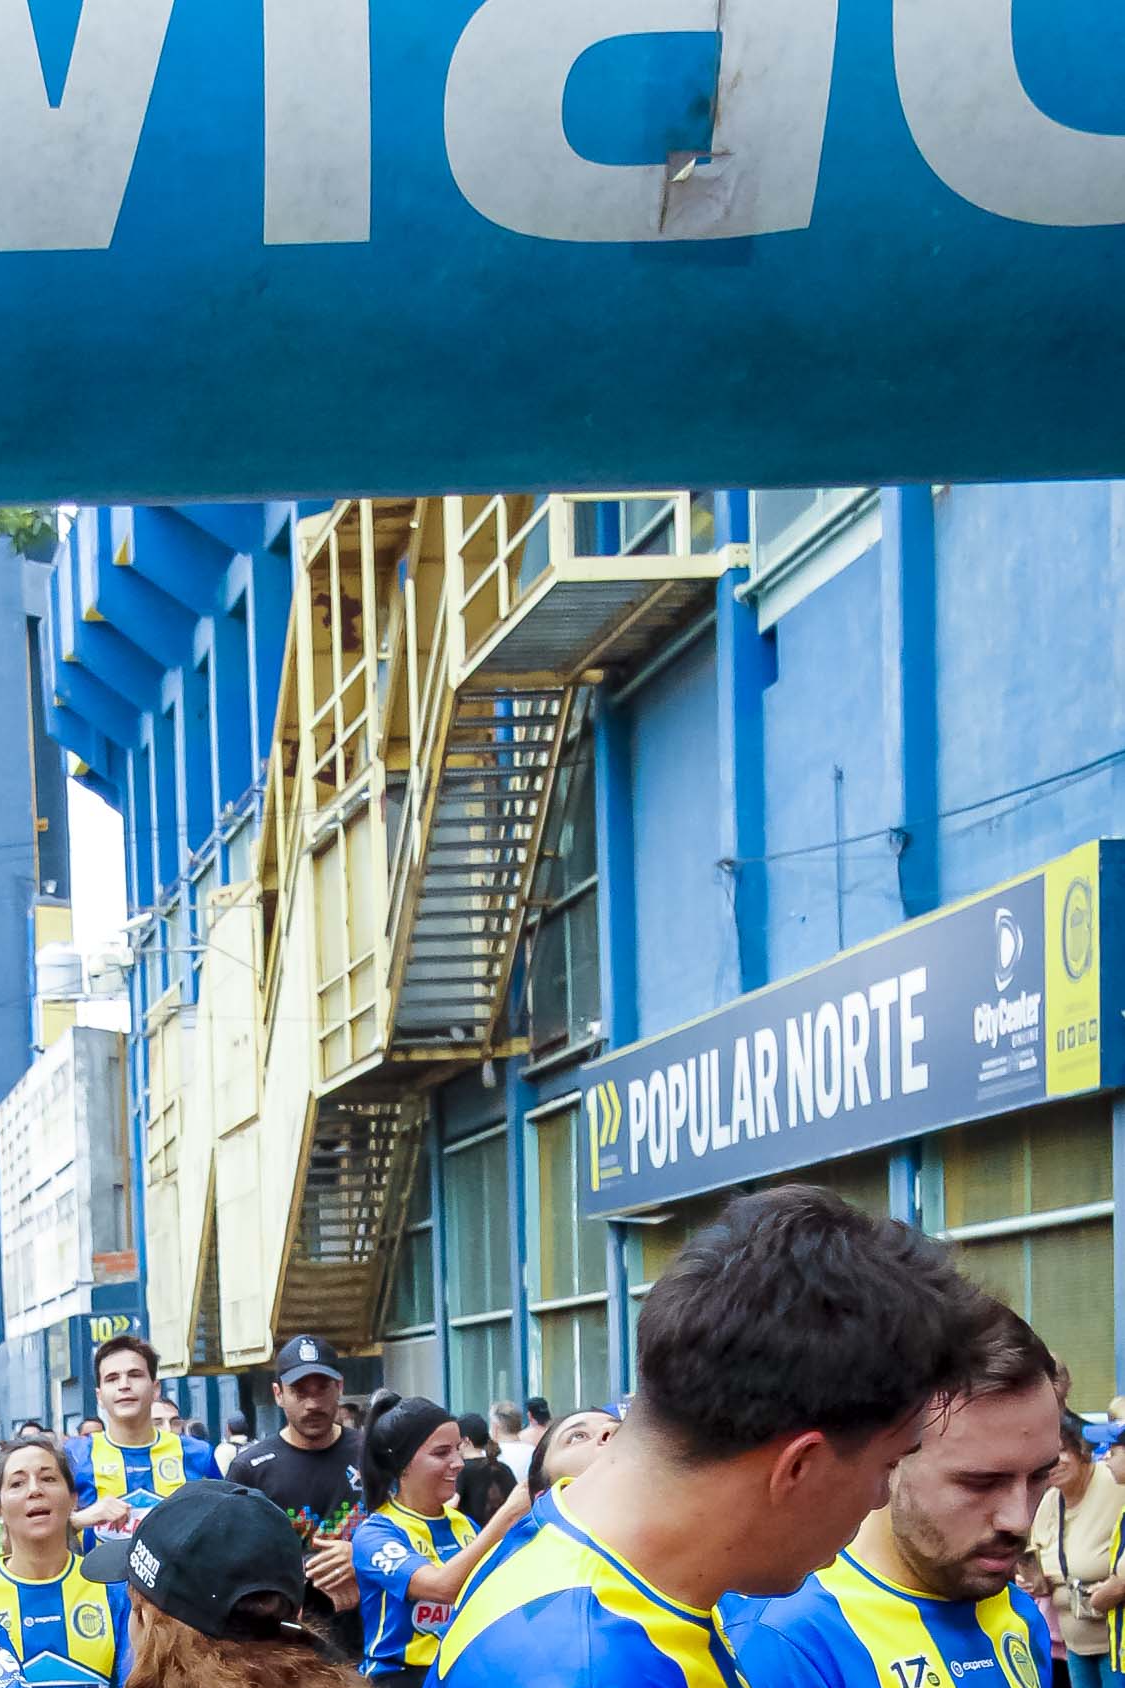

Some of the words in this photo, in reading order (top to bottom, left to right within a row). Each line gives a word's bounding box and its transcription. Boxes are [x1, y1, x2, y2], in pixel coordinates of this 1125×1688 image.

[628, 1028, 780, 1175] POPULAR
[785, 966, 929, 1128] NORTE
[963, 1658, 994, 1671] express
